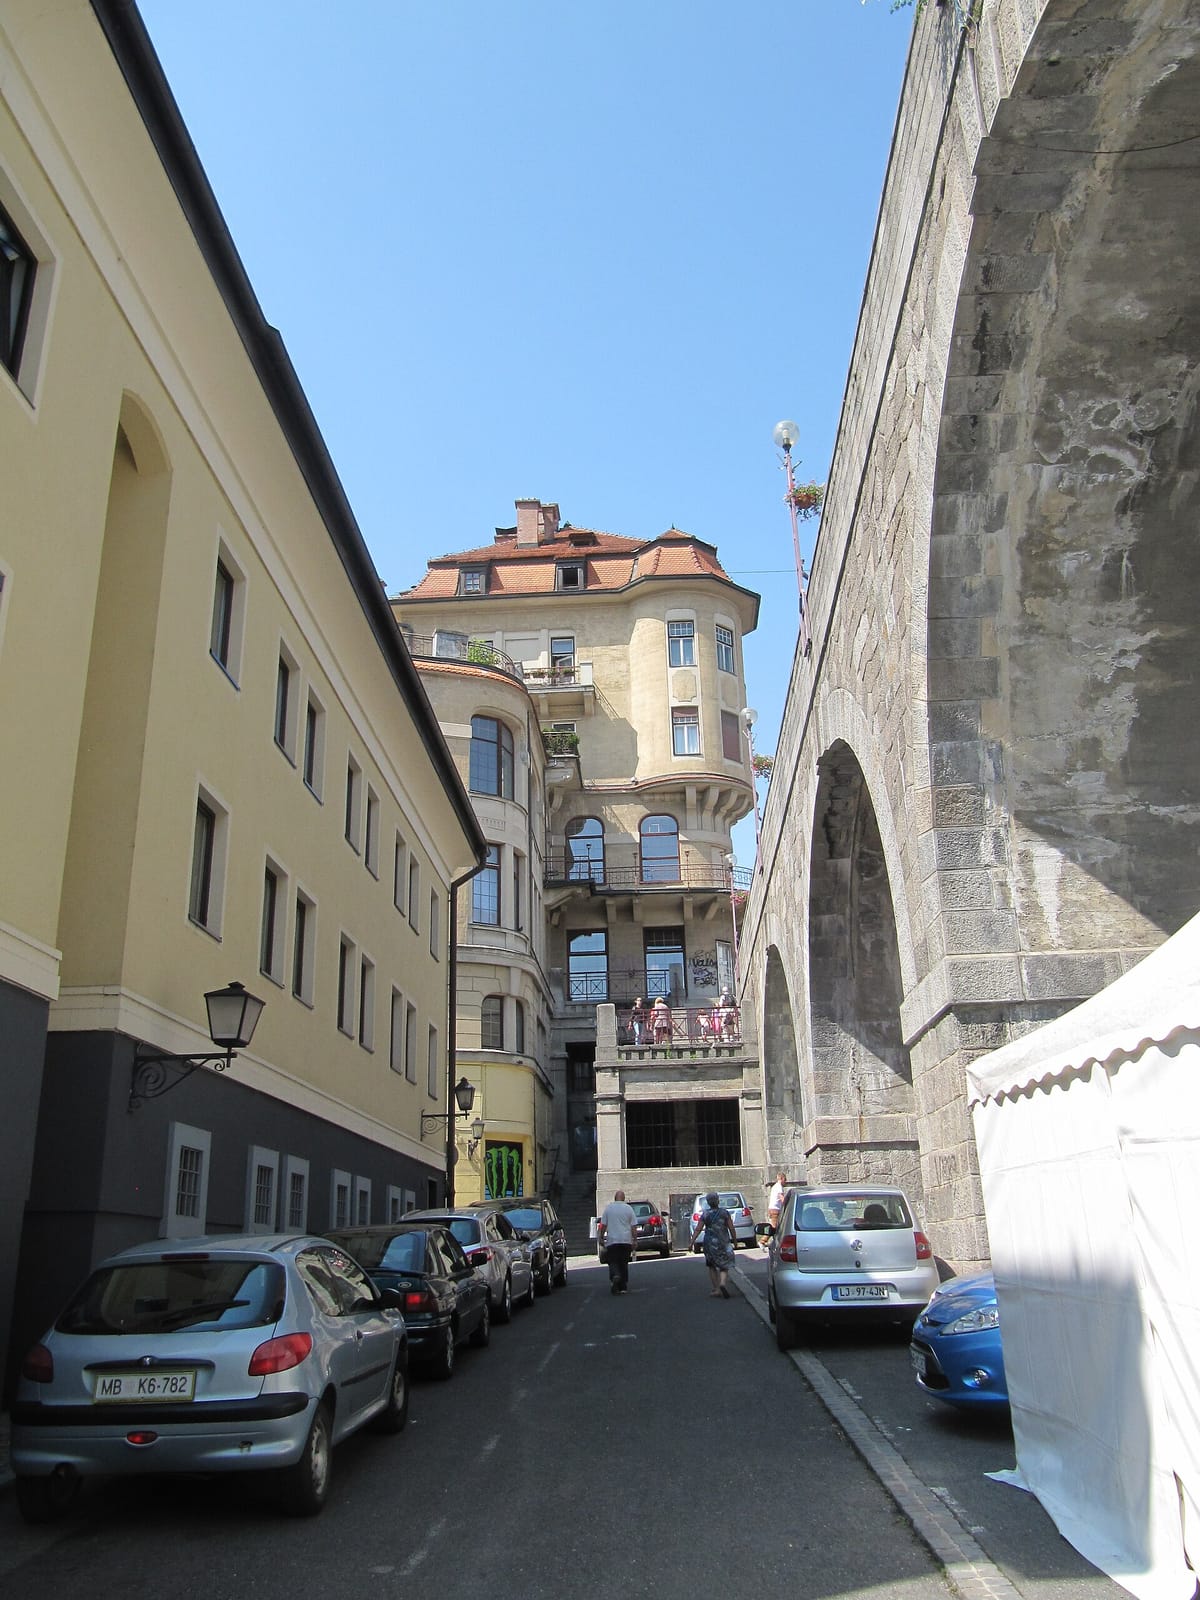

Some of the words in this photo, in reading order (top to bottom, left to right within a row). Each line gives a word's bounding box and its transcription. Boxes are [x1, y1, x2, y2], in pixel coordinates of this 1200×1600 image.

[840, 1287, 850, 1297] LJ
[101, 1378, 122, 1395] MB
[138, 1376, 188, 1394] K6-782
